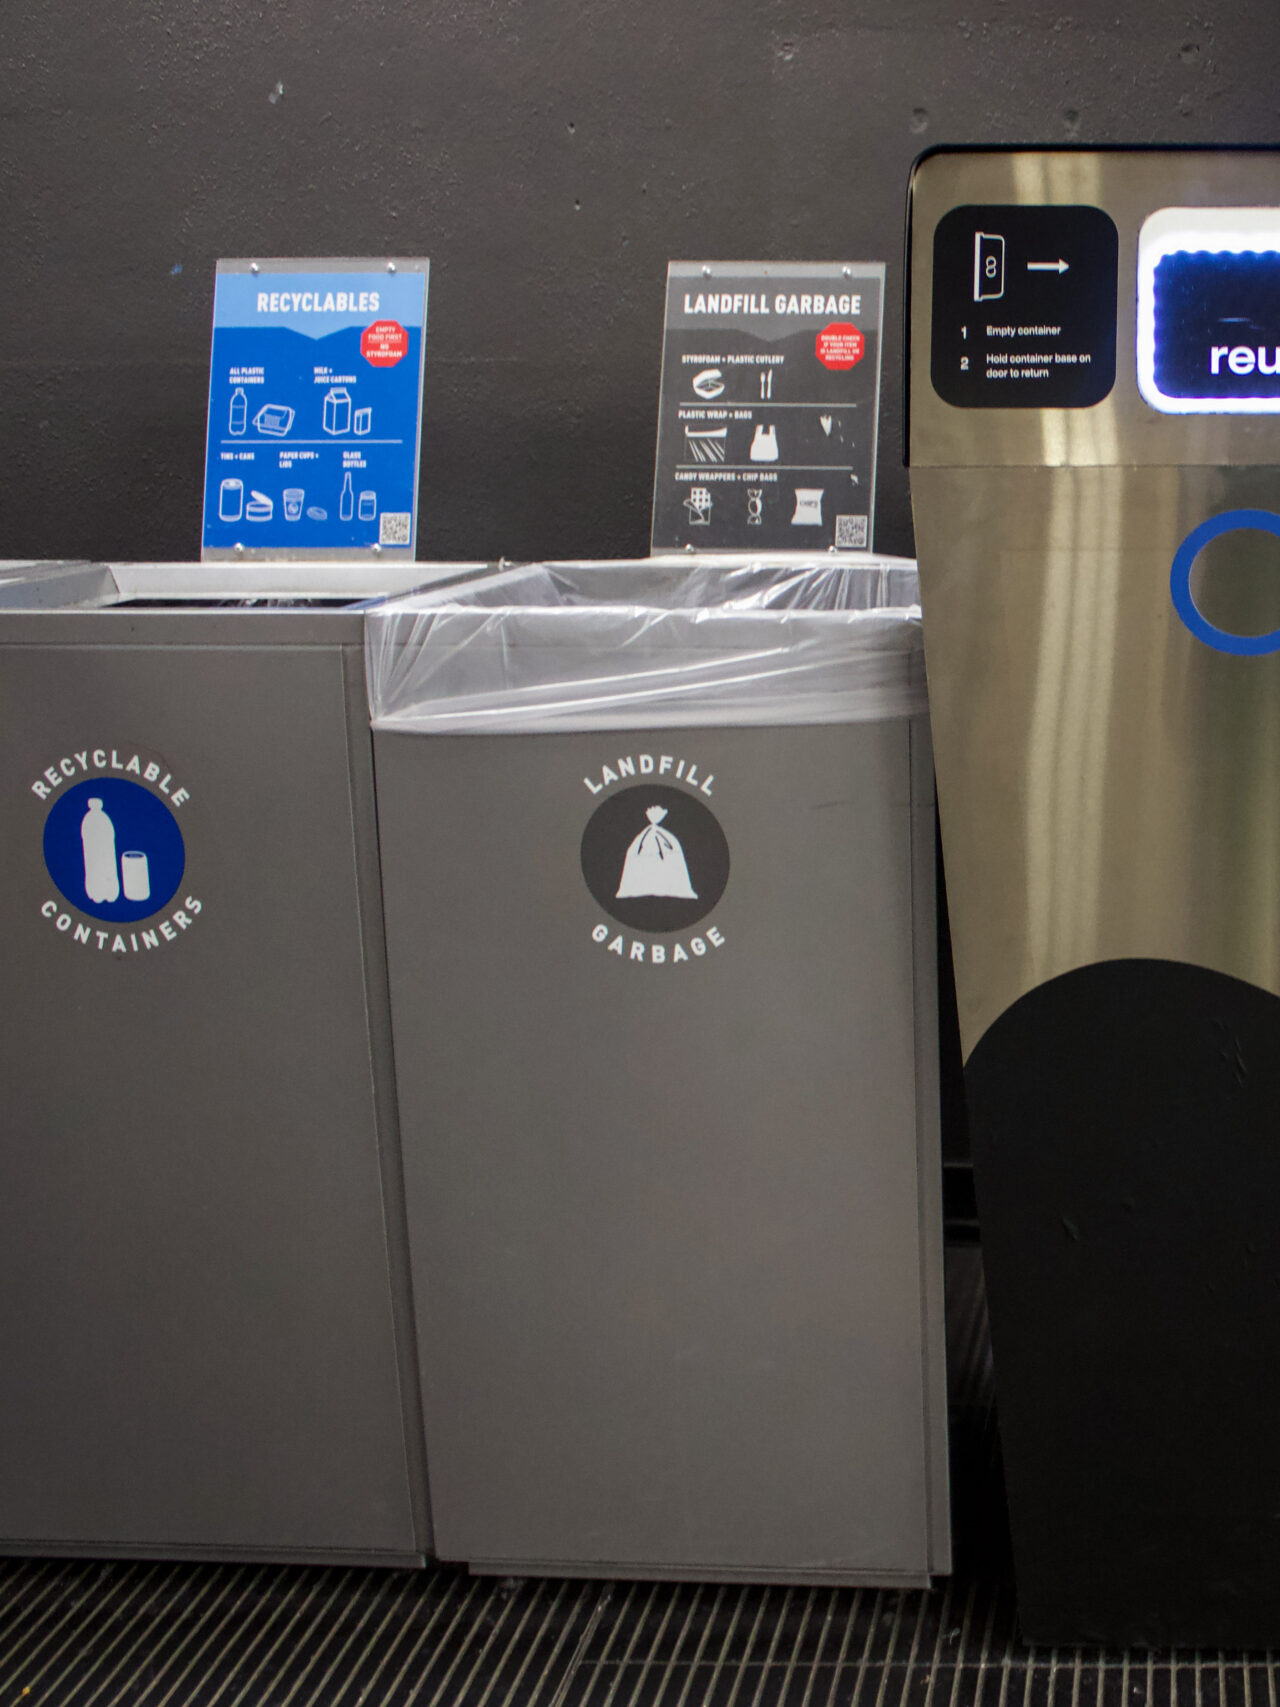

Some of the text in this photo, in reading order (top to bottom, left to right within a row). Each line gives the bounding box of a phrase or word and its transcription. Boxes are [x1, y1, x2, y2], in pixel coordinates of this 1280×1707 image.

[257, 292, 380, 312] RECYCLABLES
[684, 294, 861, 315] LANDFILL GARBAGE
[960, 325, 1061, 340] 1 Empty container
[681, 354, 720, 364] STYROFOAM
[727, 354, 754, 364] PLASTIC
[755, 354, 784, 364] CUTLERY
[960, 353, 1091, 370] 2 Hold container base on
[229, 367, 264, 375] ALL PLASTIC
[986, 368, 1049, 378] door to return
[229, 376, 264, 384] CONTAINERS
[331, 376, 357, 384] CARTONS
[678, 410, 705, 419] PLASTIC
[706, 410, 728, 419] WRAP
[734, 410, 752, 419] BAGS
[675, 472, 697, 480] CANDY
[698, 472, 735, 481] WRAPPERS
[742, 472, 758, 481] CHIP
[760, 472, 778, 482] BAGS
[31, 749, 190, 807] RECYCLABLE
[583, 754, 714, 796] LANDFILL
[41, 895, 202, 953] CONTAINERS
[592, 924, 725, 964] GARBAGE
